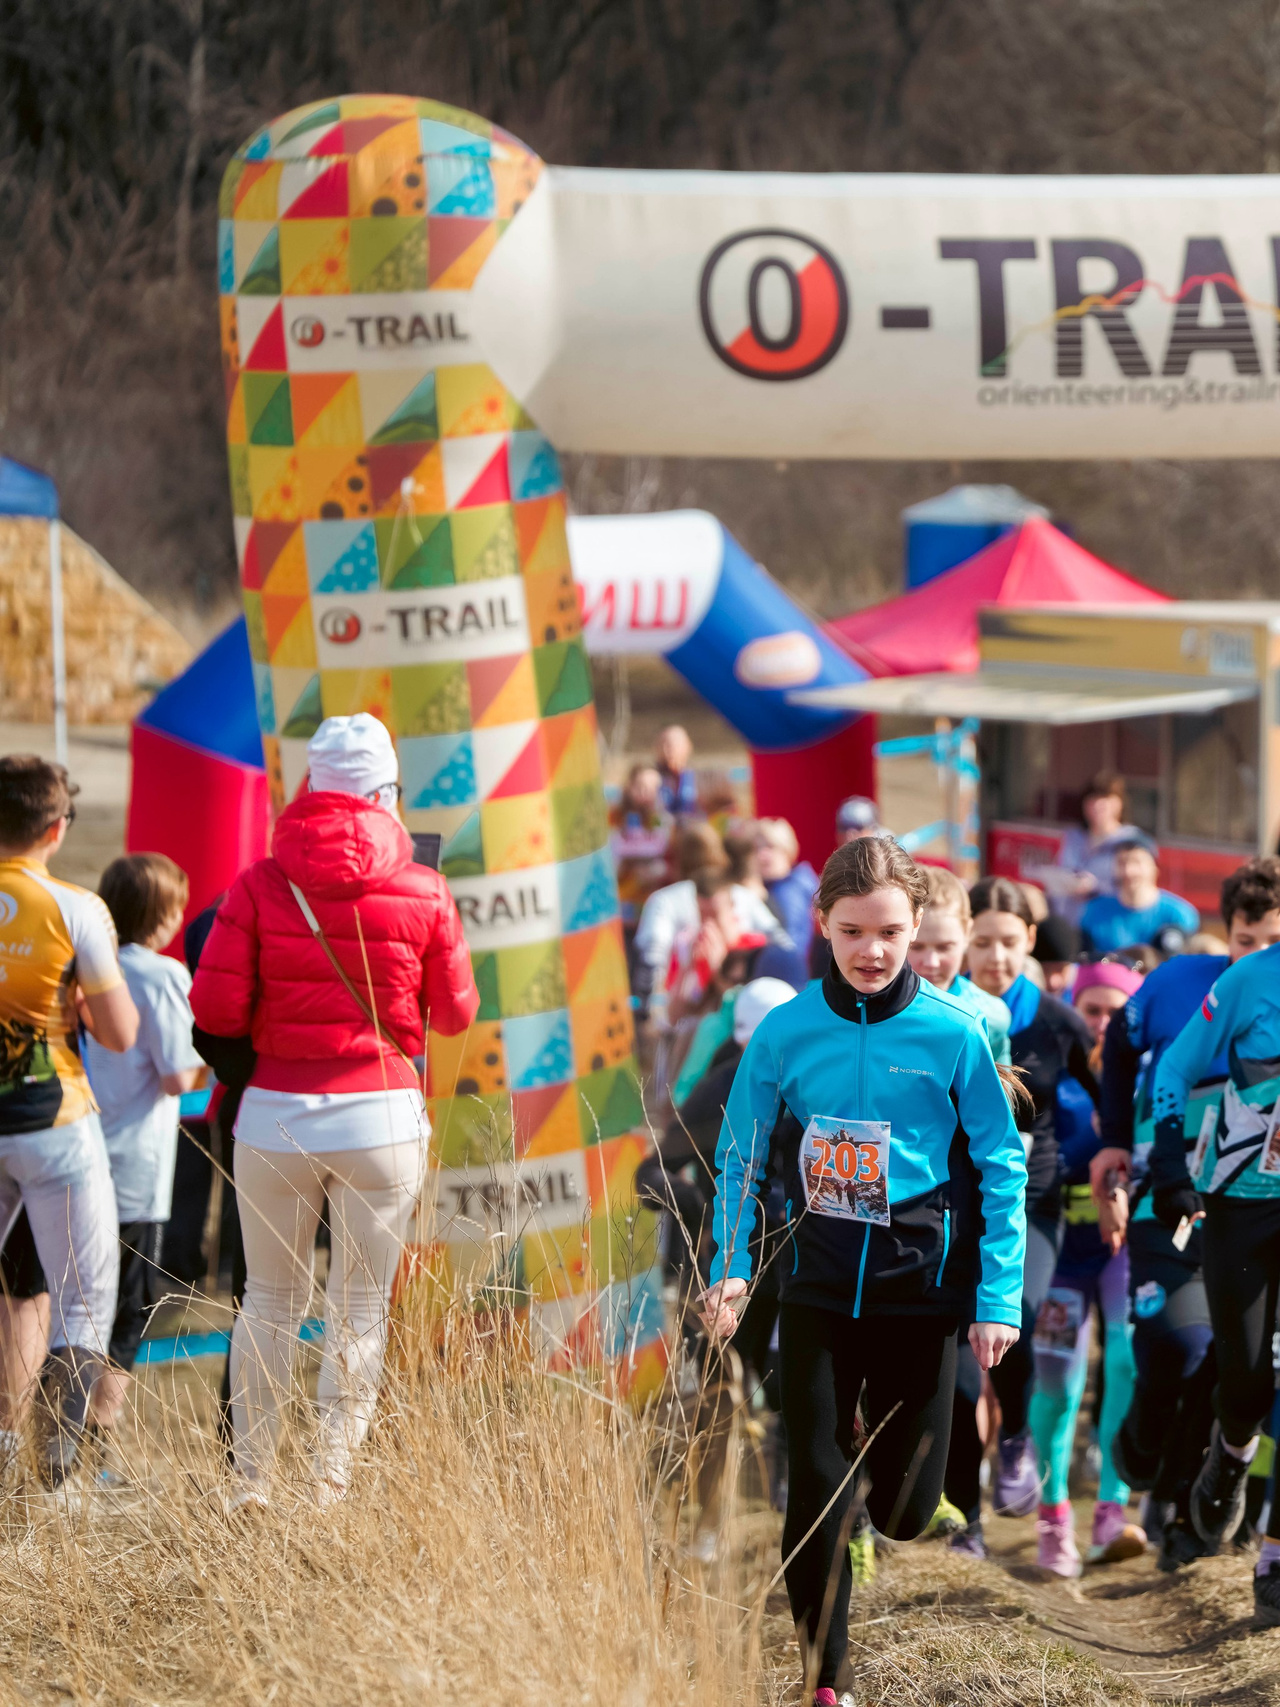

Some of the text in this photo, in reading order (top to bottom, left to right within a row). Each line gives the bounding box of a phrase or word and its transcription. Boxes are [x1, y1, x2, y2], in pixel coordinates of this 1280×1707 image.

[577, 581, 690, 630] ИШ
[455, 886, 550, 926] RAIL
[899, 1067, 935, 1077] NORDSKI
[810, 1138, 881, 1183] 203
